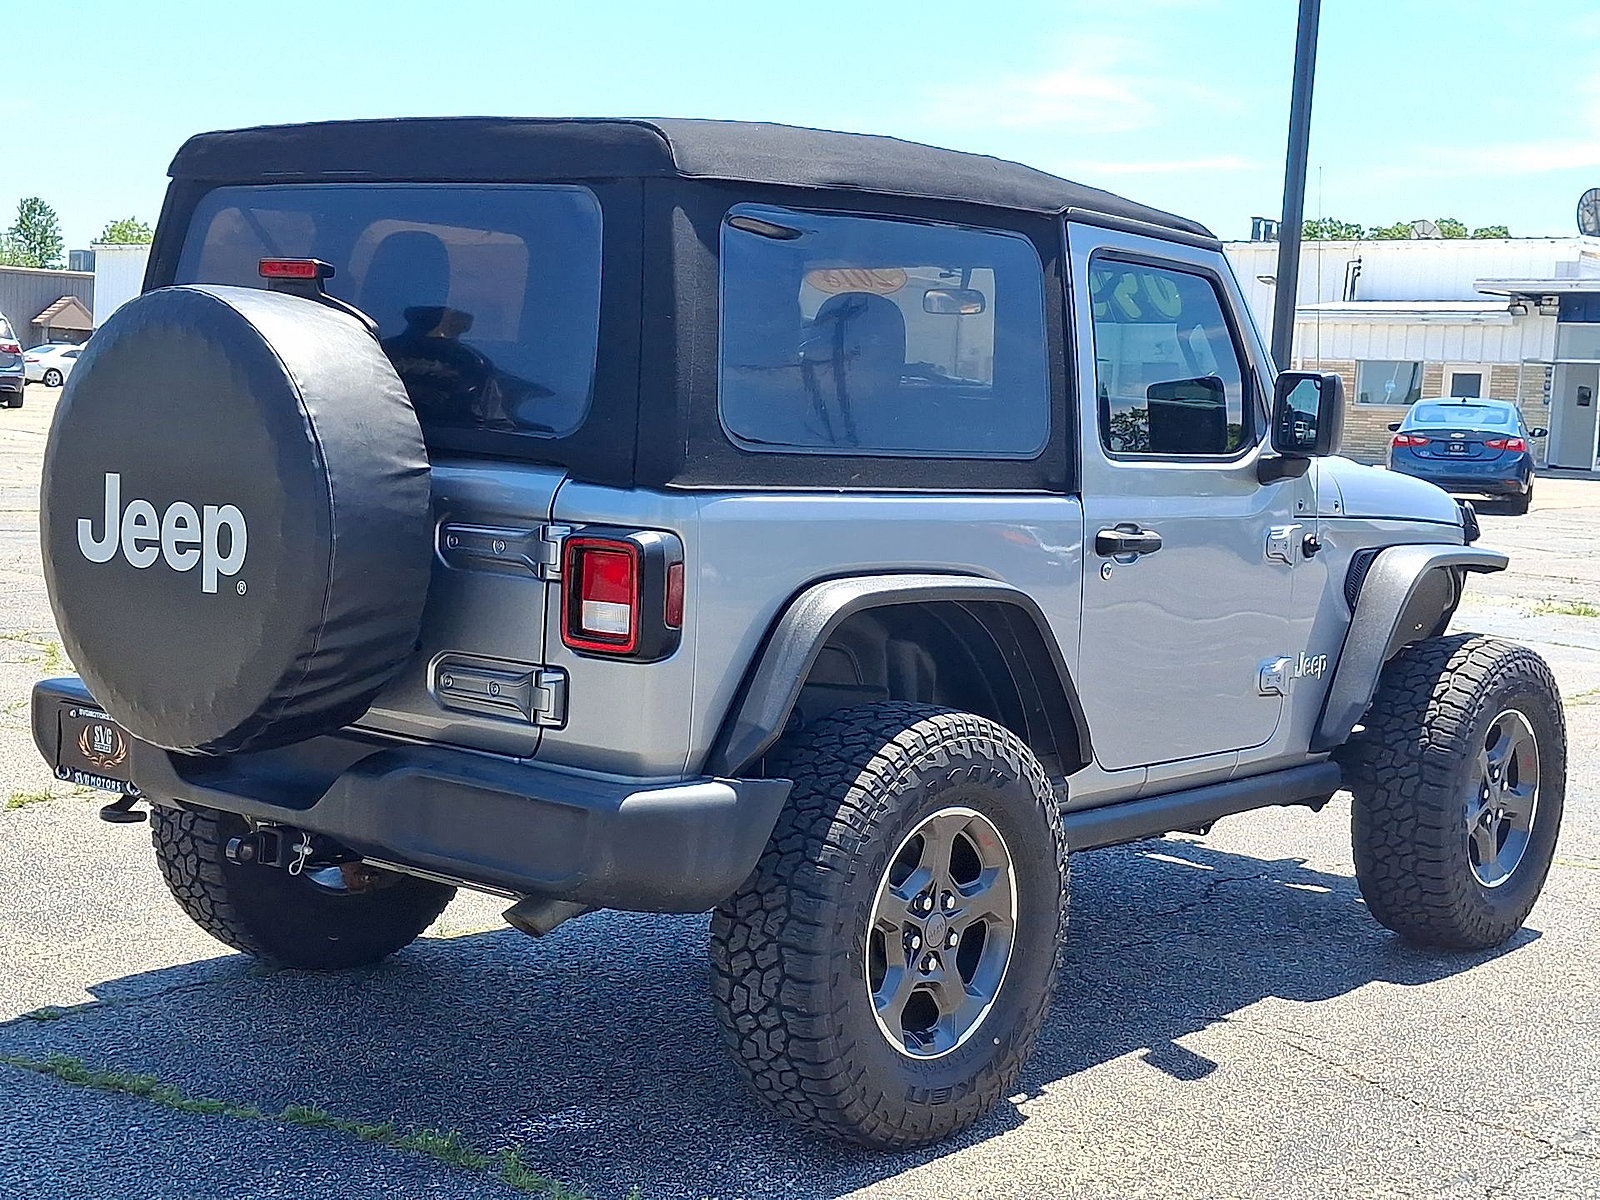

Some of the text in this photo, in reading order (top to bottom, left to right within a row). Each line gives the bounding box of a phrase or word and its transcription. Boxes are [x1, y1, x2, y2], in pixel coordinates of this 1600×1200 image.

[77, 472, 248, 594] Jeep
[1294, 651, 1327, 680] Jeep
[94, 725, 112, 745] SVG
